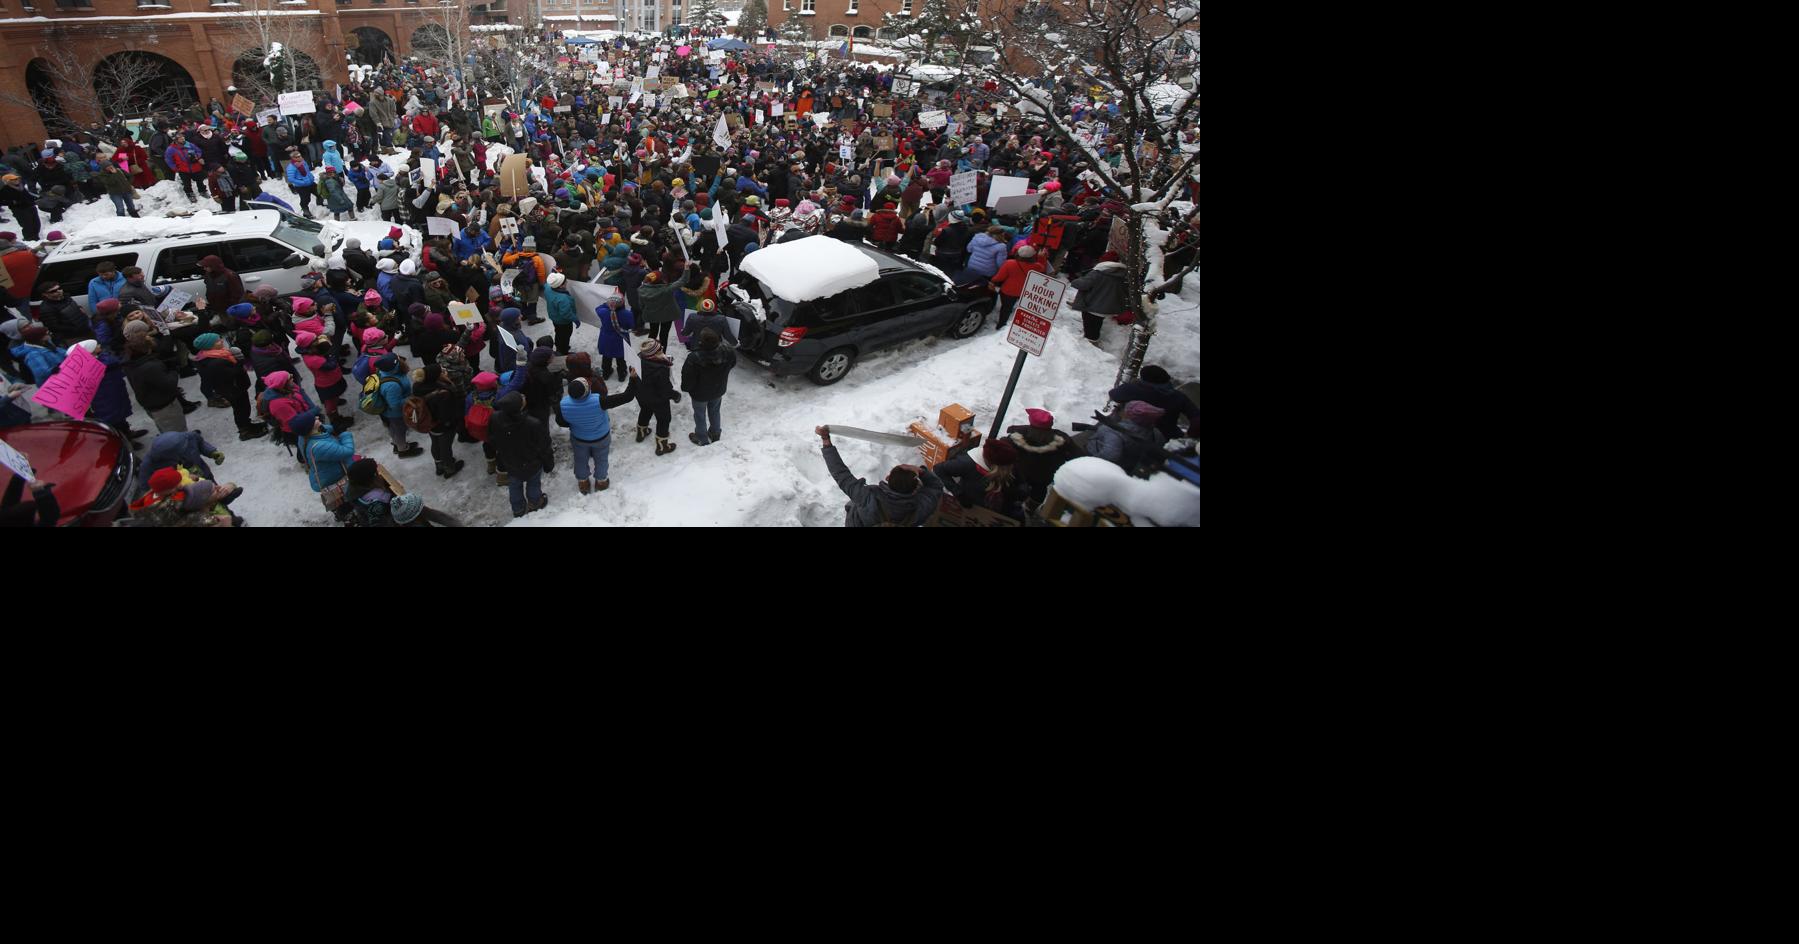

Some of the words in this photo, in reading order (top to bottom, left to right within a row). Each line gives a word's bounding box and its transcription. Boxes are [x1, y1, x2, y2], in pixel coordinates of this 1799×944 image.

[1042, 278, 1050, 287] 2
[1031, 284, 1055, 299] HOUR
[1023, 291, 1057, 310] PARKING
[1027, 302, 1047, 314] ONLY
[71, 376, 88, 394] WE
